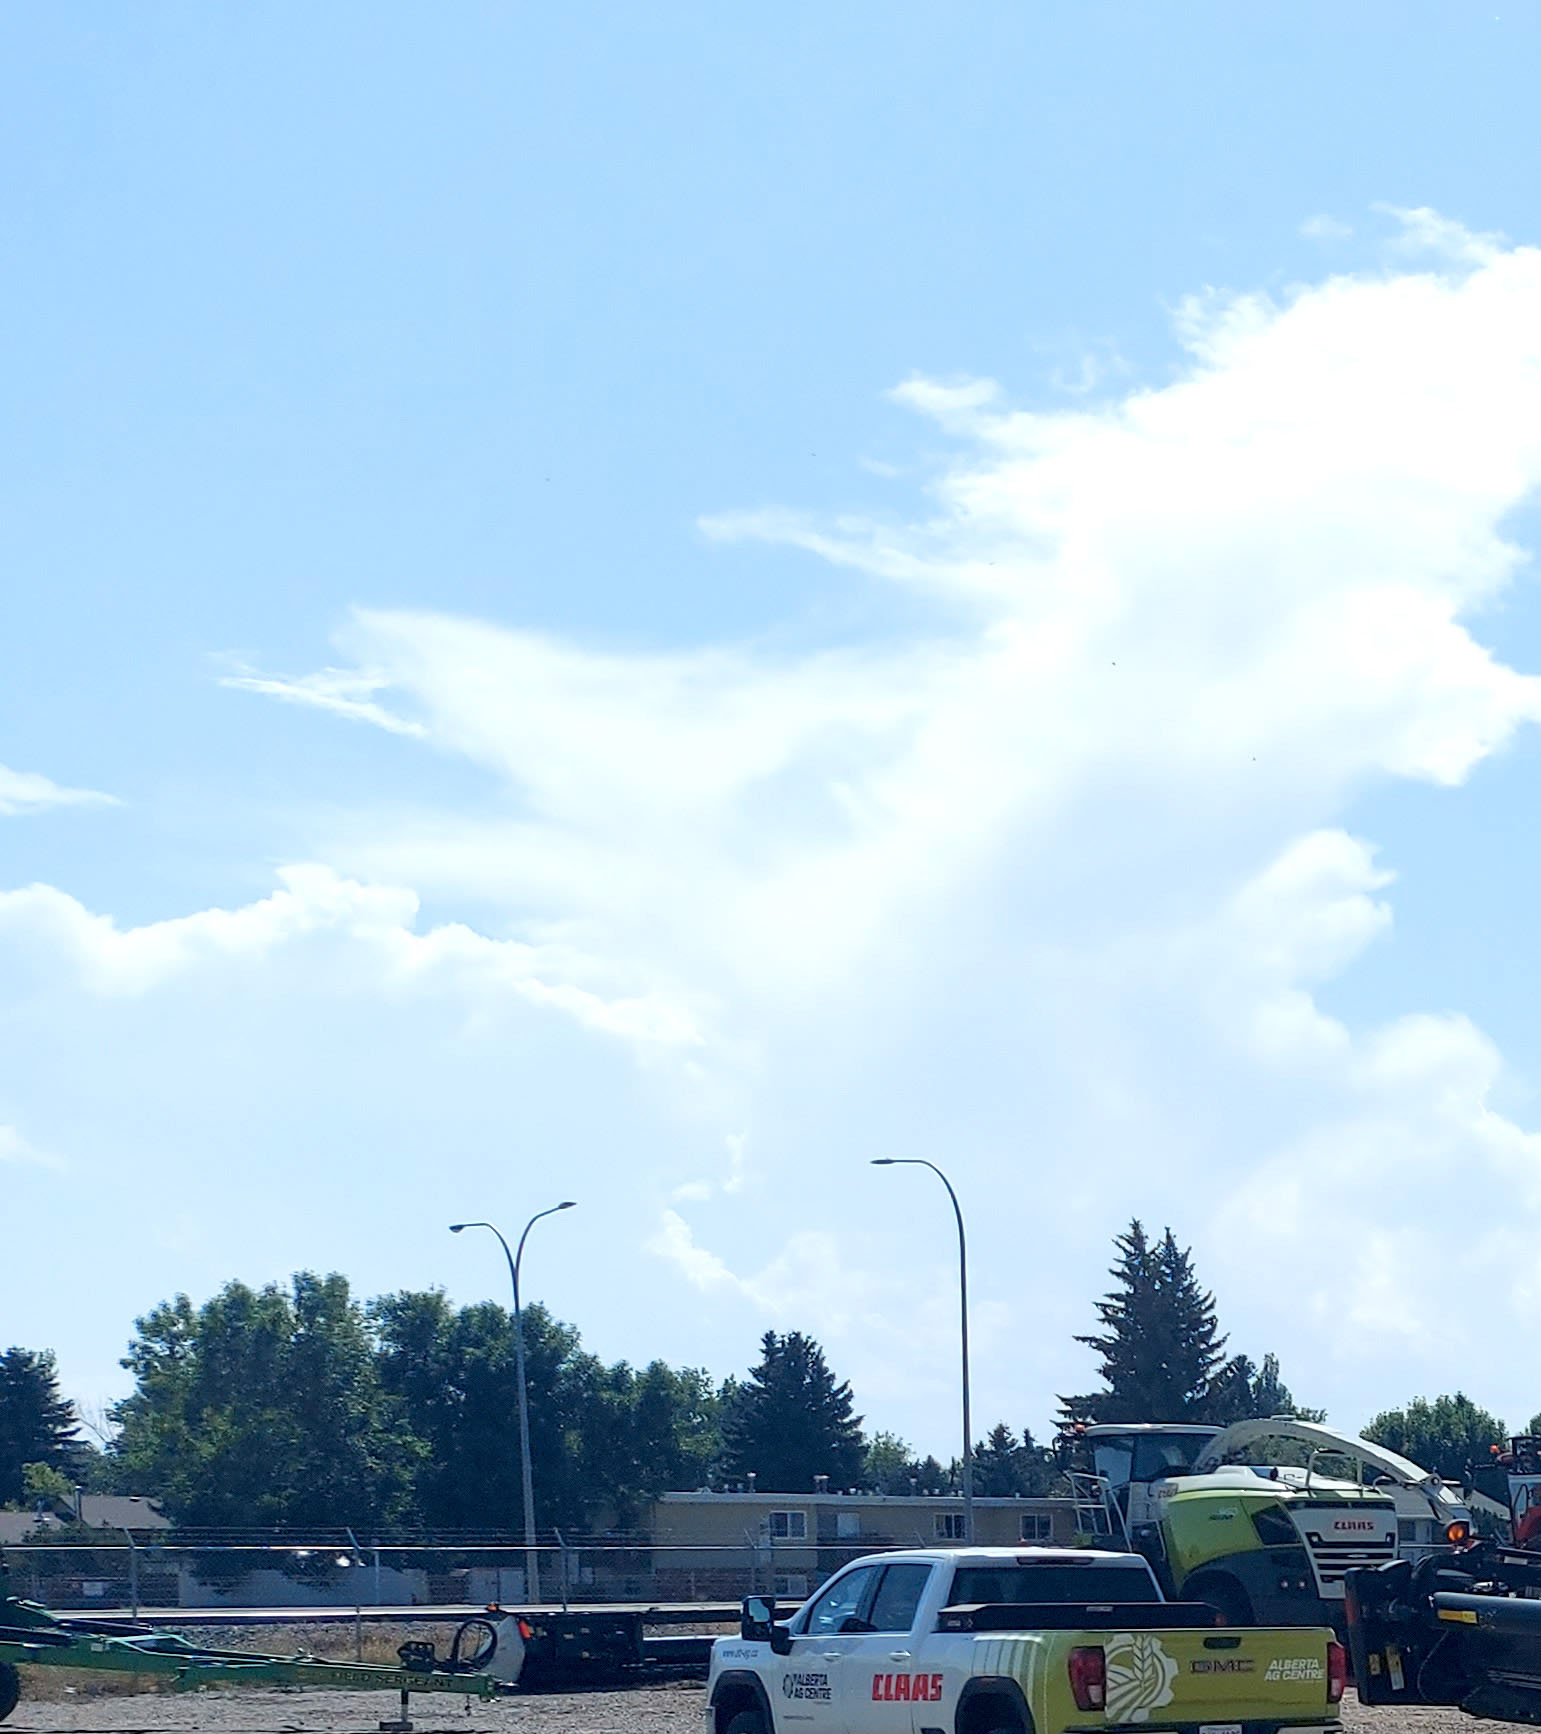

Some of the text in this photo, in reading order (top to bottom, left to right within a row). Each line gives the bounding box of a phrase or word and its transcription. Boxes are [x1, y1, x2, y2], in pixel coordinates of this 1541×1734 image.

[1333, 1521, 1374, 1531] CLAAS
[1191, 1660, 1255, 1674] GMC
[1269, 1659, 1320, 1670] ALBERTA
[795, 1673, 828, 1687] ALBERTA
[1264, 1669, 1324, 1681] AG CENTRE
[804, 1687, 832, 1700] CENTRE
[872, 1673, 944, 1702] CLAAS
